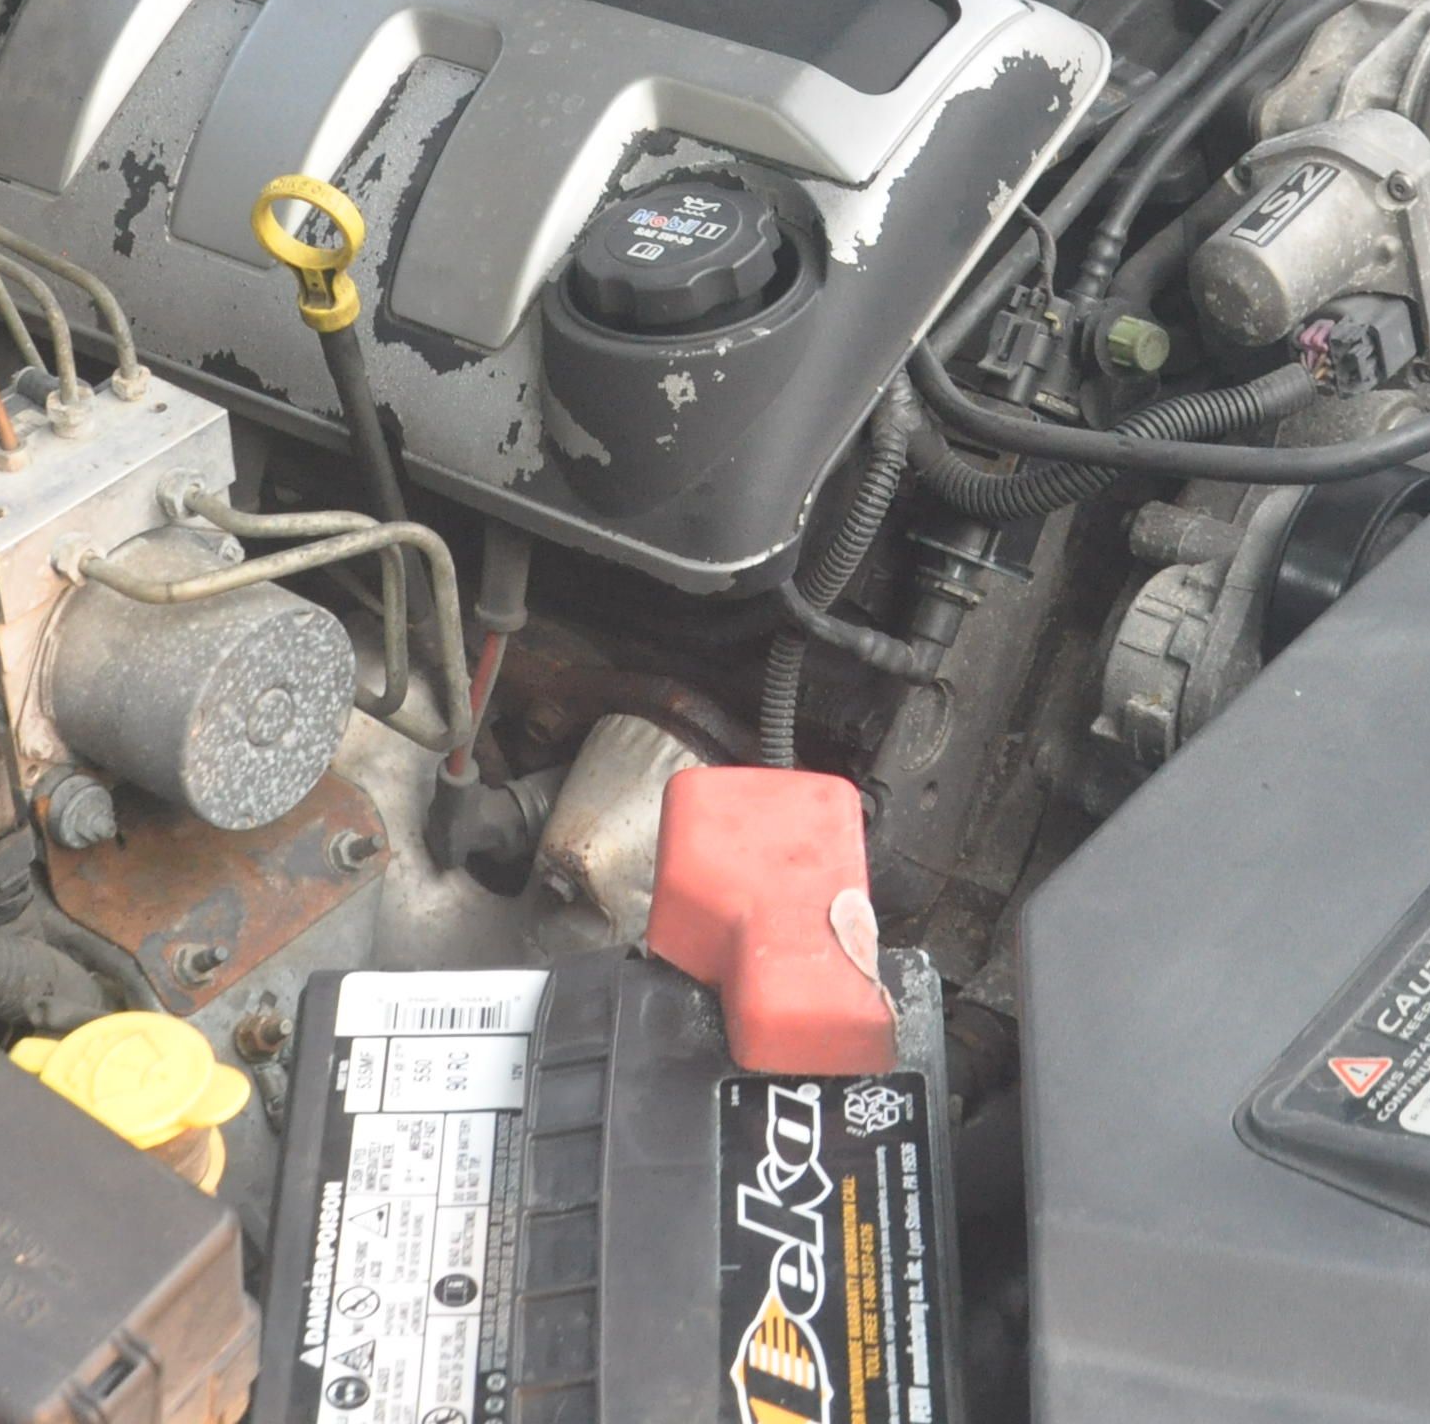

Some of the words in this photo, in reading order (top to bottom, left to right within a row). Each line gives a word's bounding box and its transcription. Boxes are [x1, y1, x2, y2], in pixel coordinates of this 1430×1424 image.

[1232, 164, 1331, 243] LS2
[627, 208, 702, 235] Mobil
[633, 227, 658, 238] SAE
[414, 1059, 431, 1083] 550
[447, 1052, 469, 1071] RC
[511, 1063, 524, 1080] 12V
[446, 1077, 467, 1091] 90
[1363, 1068, 1406, 1109] FANS
[900, 1142, 917, 1174] 19536
[903, 1175, 917, 1190] PA
[731, 1083, 834, 1424] Deka
[842, 1203, 858, 1275] INFORMATION
[906, 1230, 925, 1257] Lyon
[845, 1277, 861, 1337] WARRANTY
[863, 1312, 879, 1344] FREE
[906, 1302, 930, 1385] manufacturing
[848, 1340, 865, 1409] NATIONWIDE
[864, 1345, 880, 1379] TOLL
